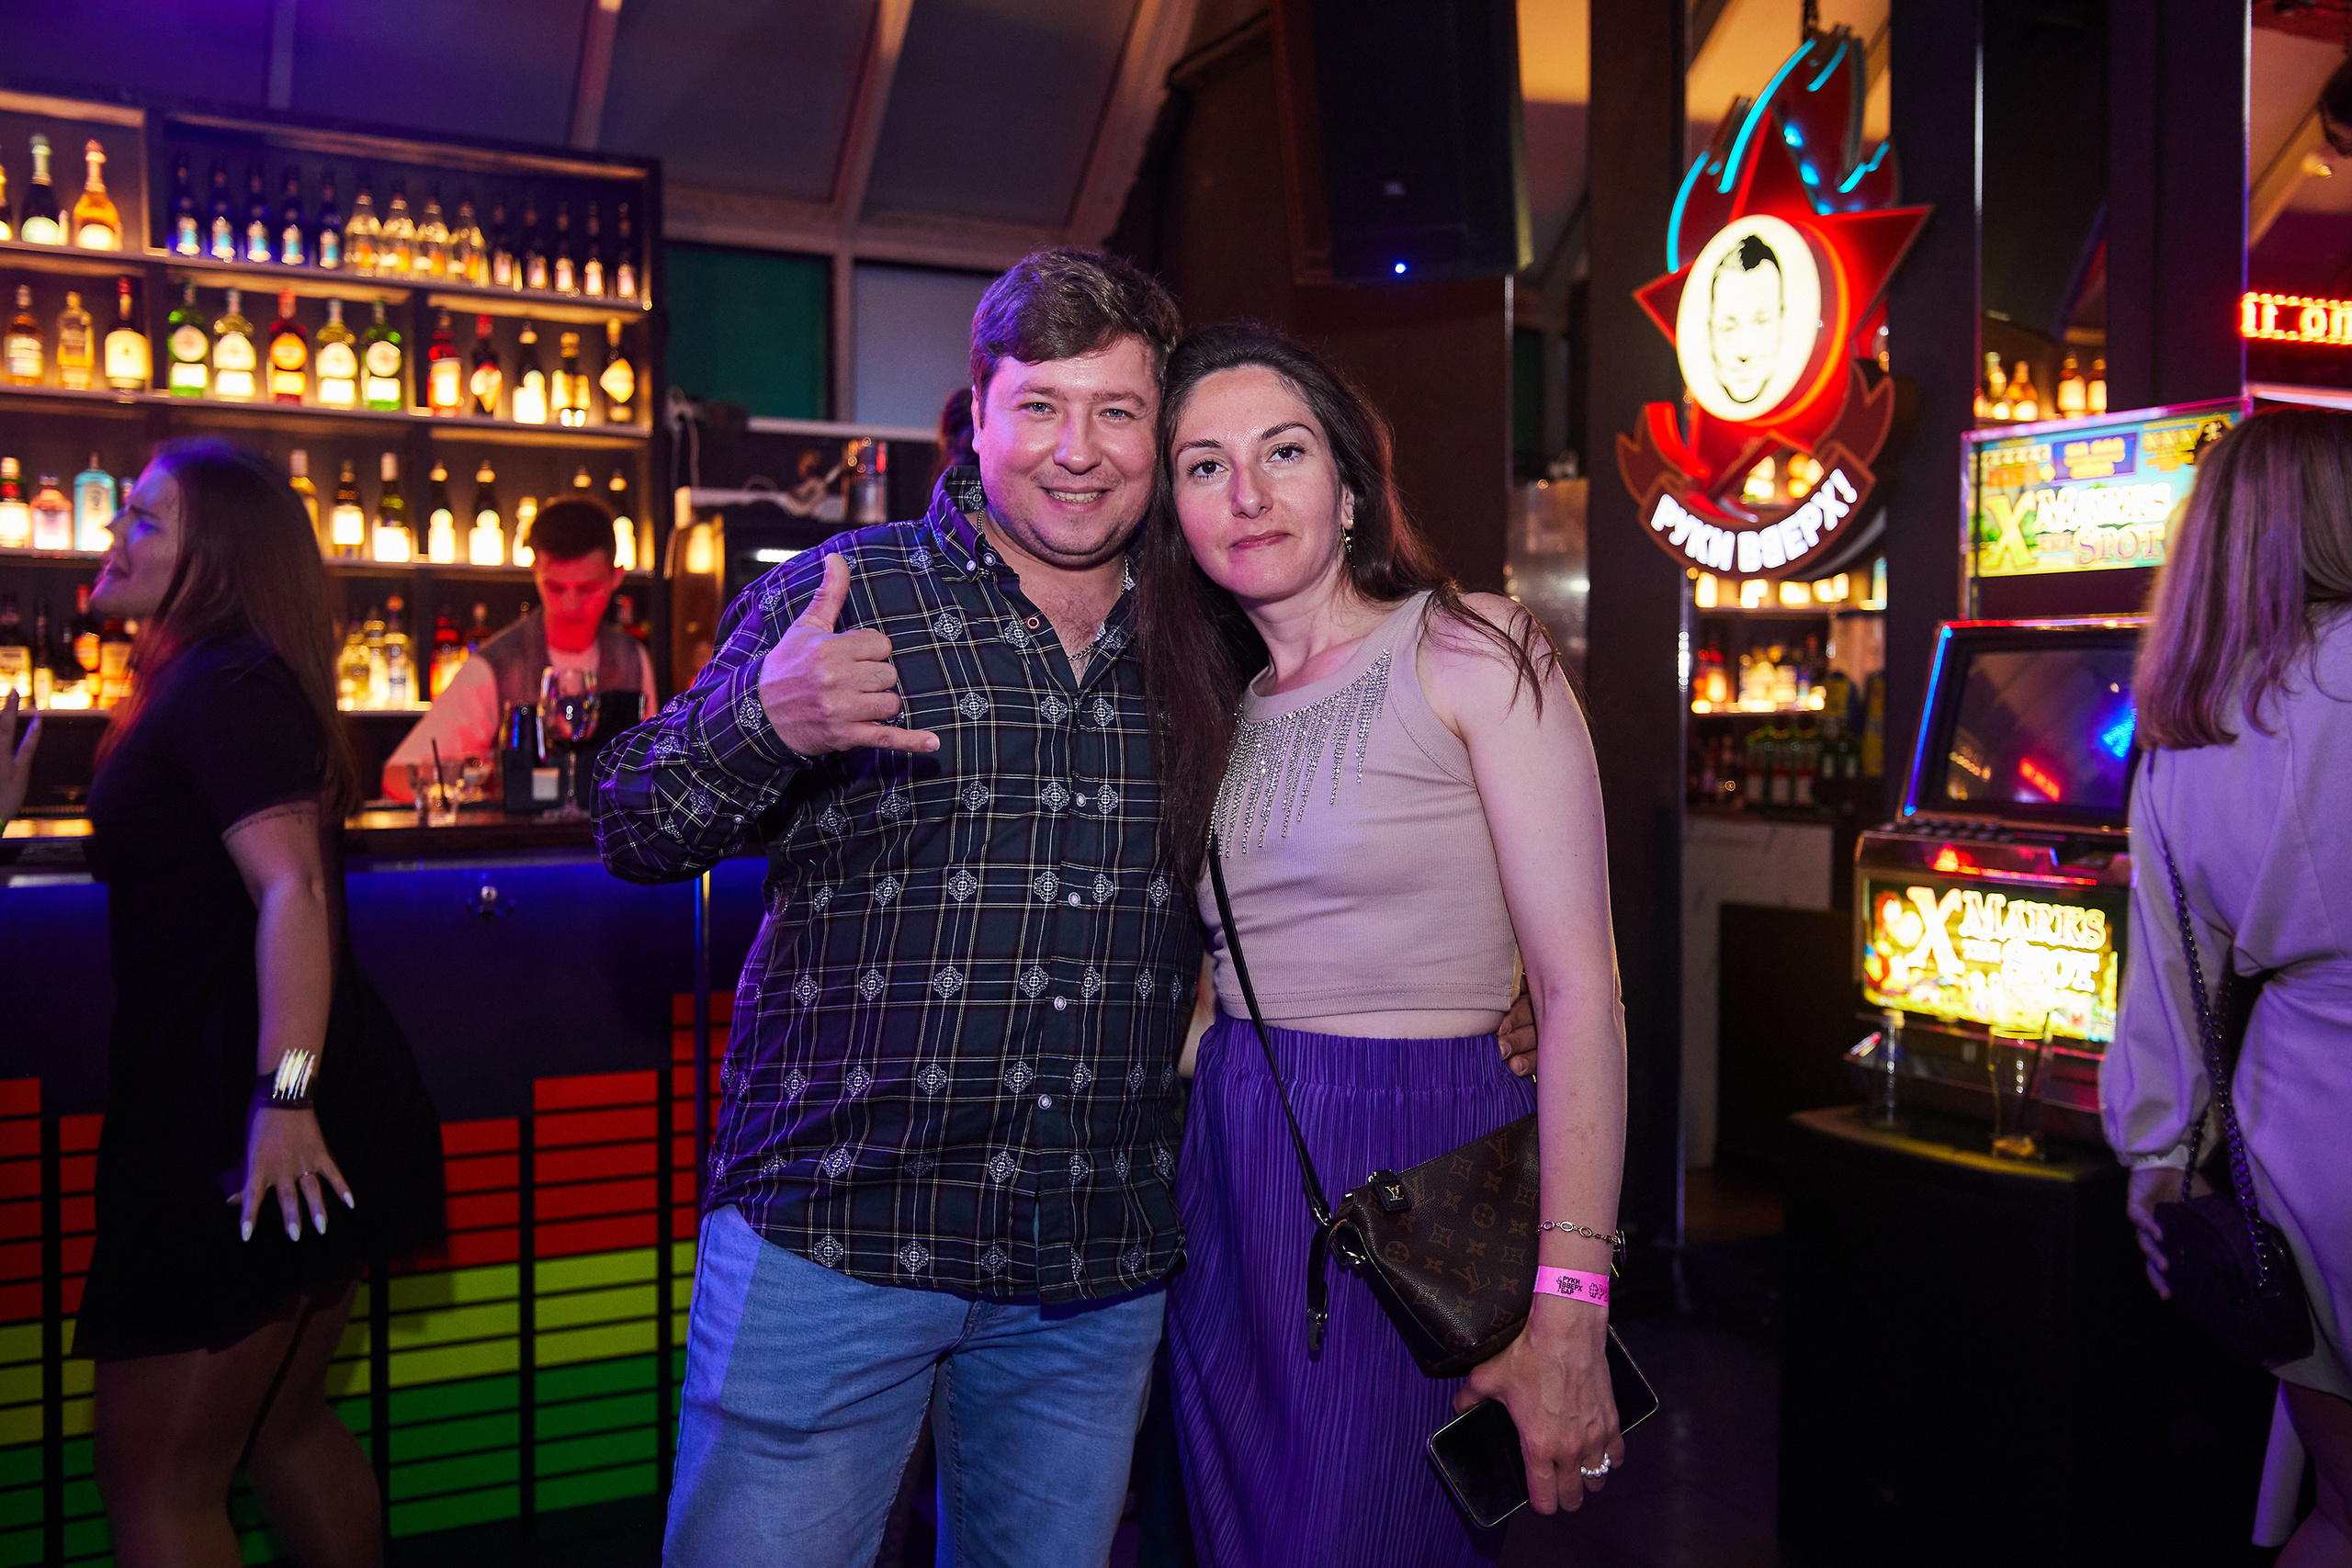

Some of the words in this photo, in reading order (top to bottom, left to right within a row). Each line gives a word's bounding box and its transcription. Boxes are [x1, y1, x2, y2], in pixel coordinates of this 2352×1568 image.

[1650, 493, 1736, 571] РУКИ
[1736, 468, 1858, 573] ВВЕРХ!
[1981, 489, 2037, 570] X
[2075, 524, 2166, 565] SPOT
[1905, 886, 1965, 976] X
[1958, 890, 2107, 950] MARKS
[1561, 1287, 1575, 1295] БАР
[1562, 1281, 1583, 1292] ВВЕРХ
[1563, 1276, 1580, 1285] РУКИ
